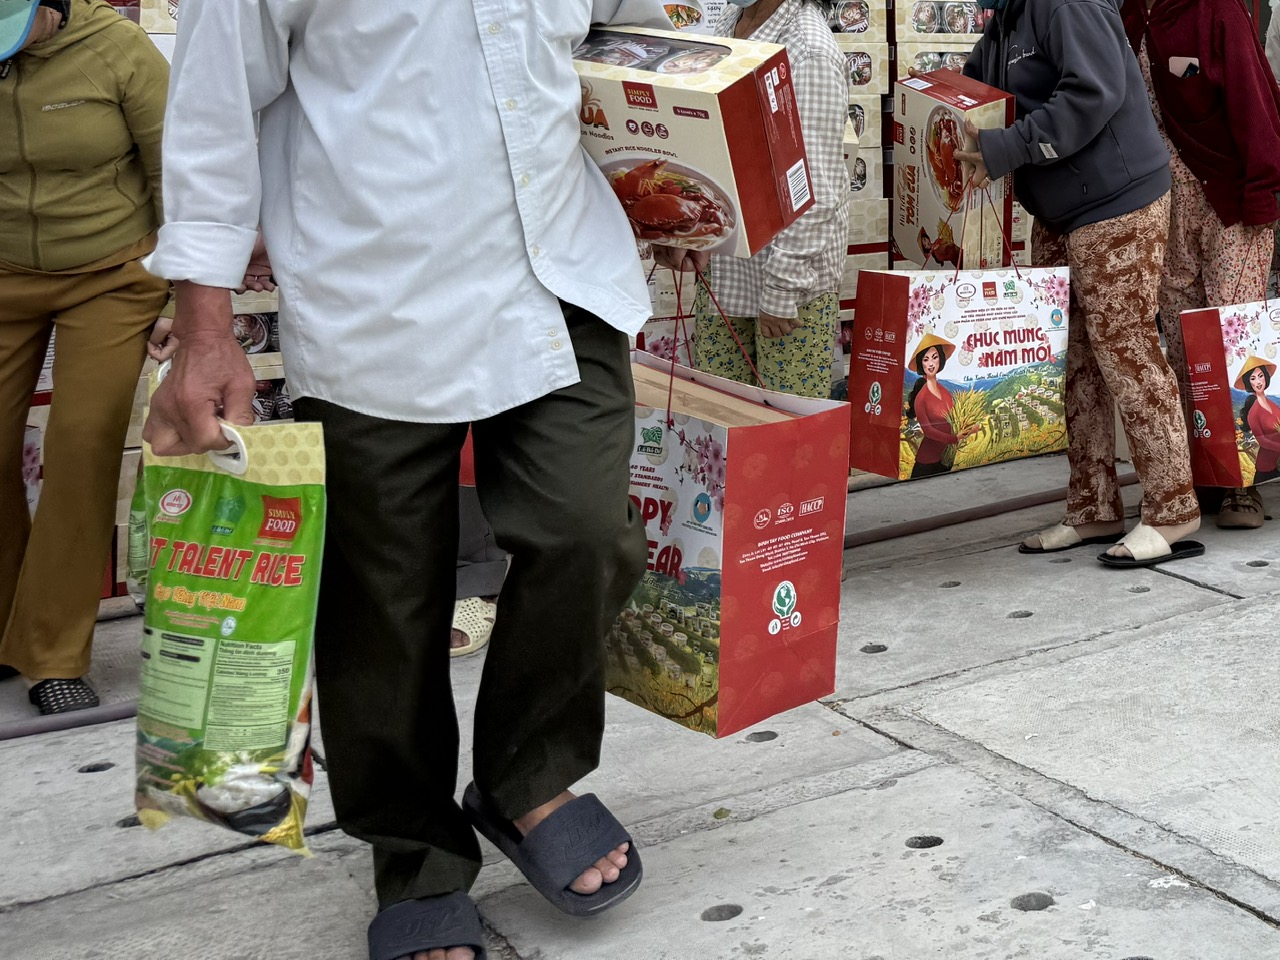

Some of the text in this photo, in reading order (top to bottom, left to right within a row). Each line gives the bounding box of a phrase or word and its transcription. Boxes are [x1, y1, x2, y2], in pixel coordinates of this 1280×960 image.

[630, 95, 652, 104] FOOD
[581, 106, 610, 130] UA
[777, 506, 794, 516] ISO
[801, 499, 823, 514] HACCP
[268, 508, 295, 520] SIMPLY
[265, 519, 296, 533] FOOD
[168, 540, 253, 580] TALENT
[251, 552, 305, 587] RICE
[646, 539, 683, 580] EAR
